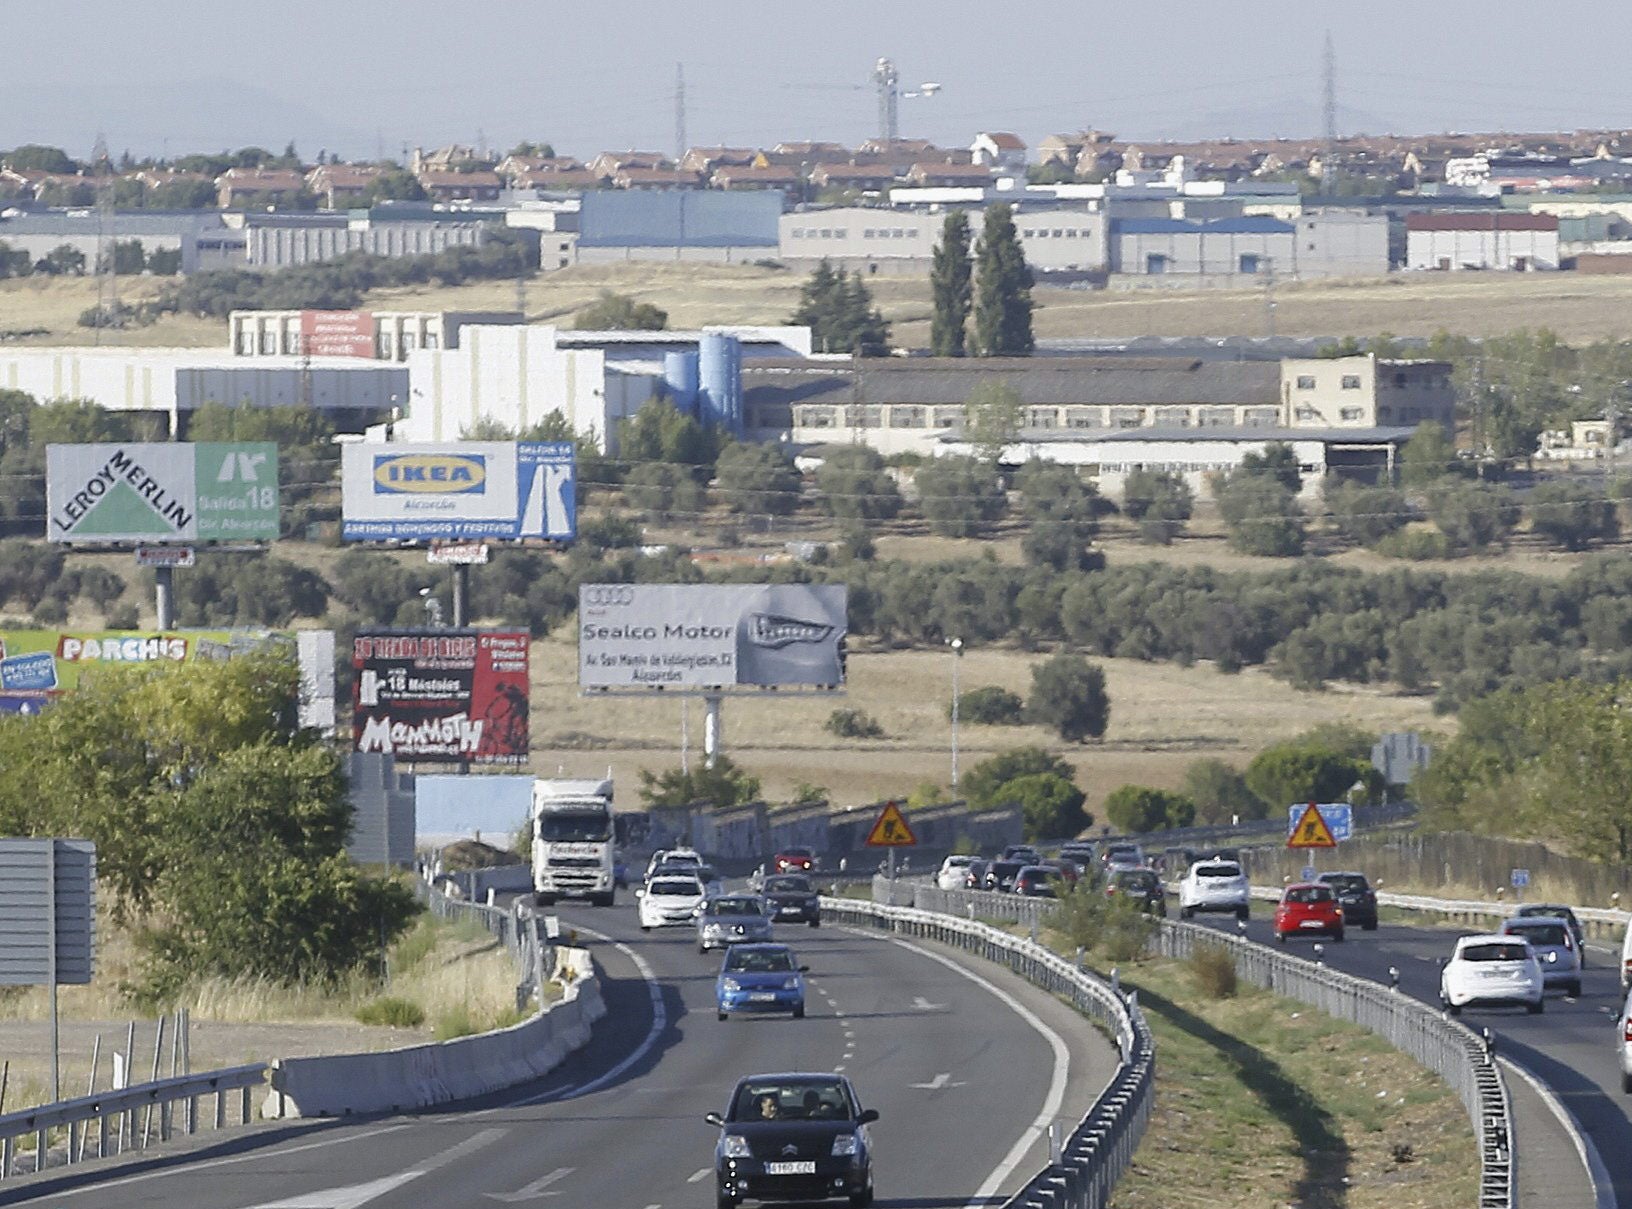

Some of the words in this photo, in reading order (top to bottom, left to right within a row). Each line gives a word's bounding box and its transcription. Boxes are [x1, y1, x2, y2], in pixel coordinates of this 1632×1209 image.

[388, 465, 473, 482] IKEA
[53, 464, 116, 532] LEROY
[109, 449, 193, 531] MERLIN
[246, 485, 275, 511] 18
[583, 623, 657, 641] Sealco
[663, 623, 734, 640] Motor
